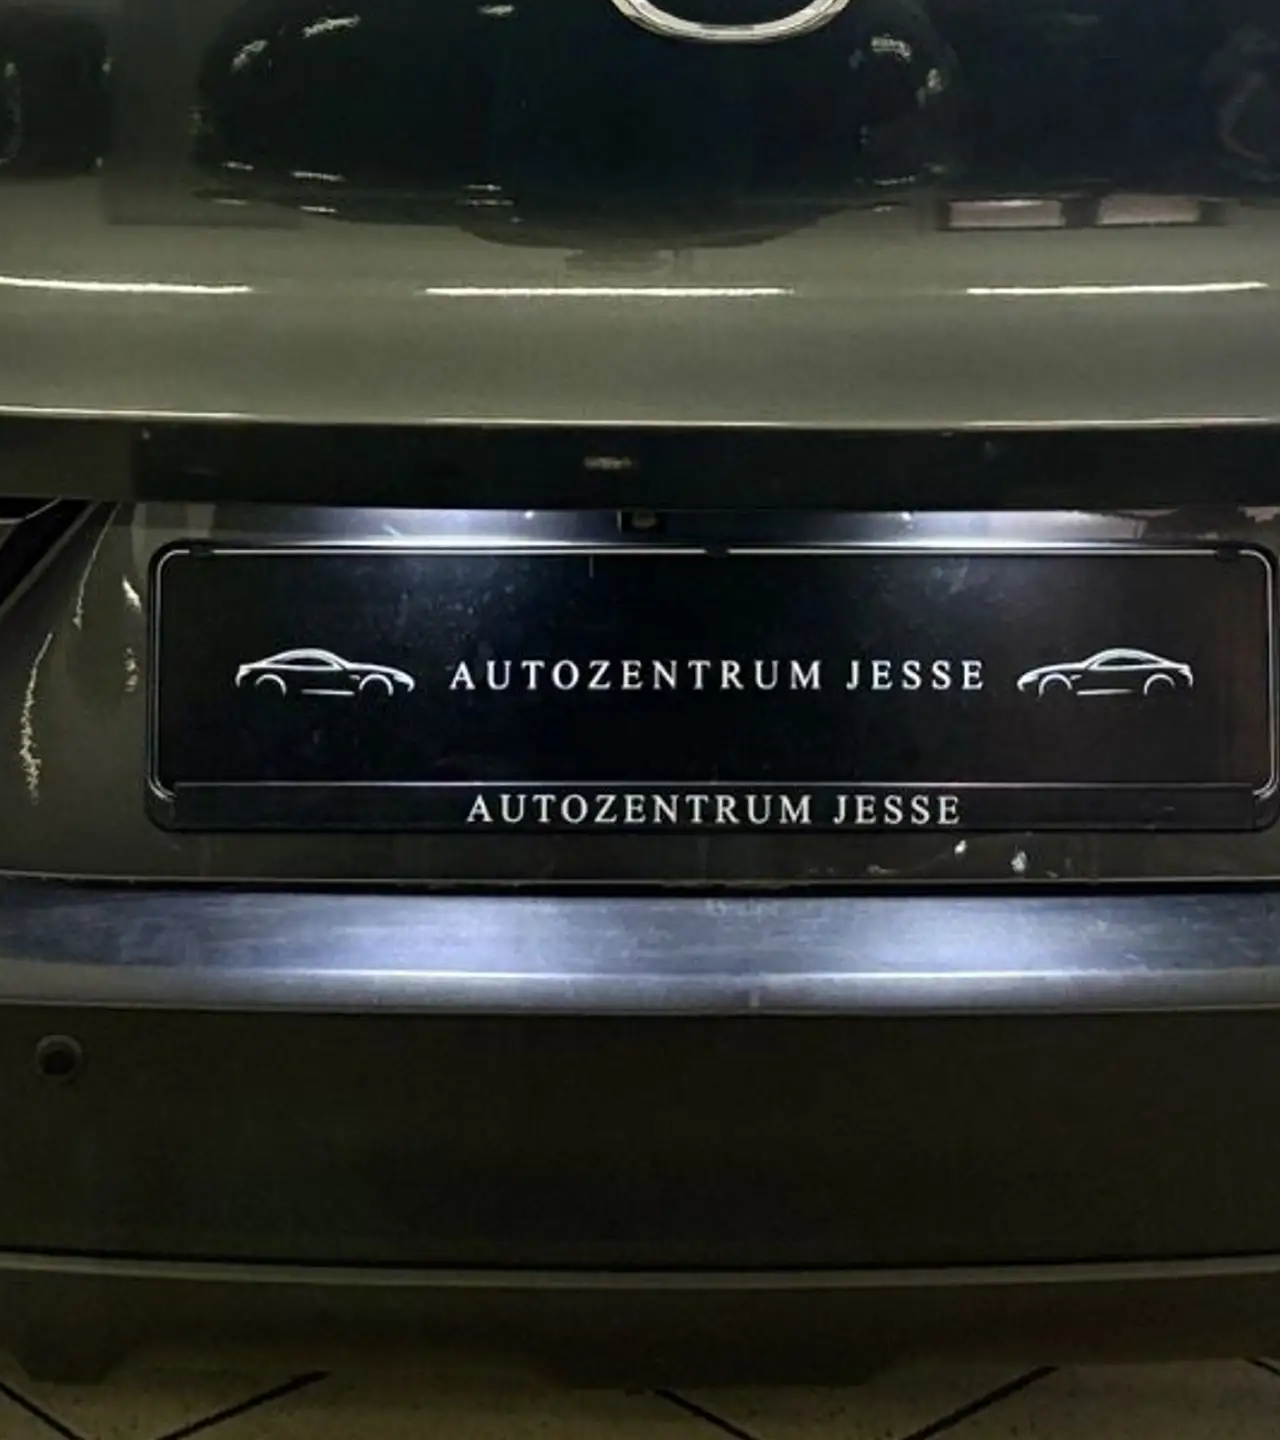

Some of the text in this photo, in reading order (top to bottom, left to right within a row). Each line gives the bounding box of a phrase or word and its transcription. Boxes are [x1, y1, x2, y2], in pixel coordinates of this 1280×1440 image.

[449, 659, 984, 691] AUTOZENTRUM JESSE
[467, 794, 961, 826] AUTOZENTRUM JESSE
